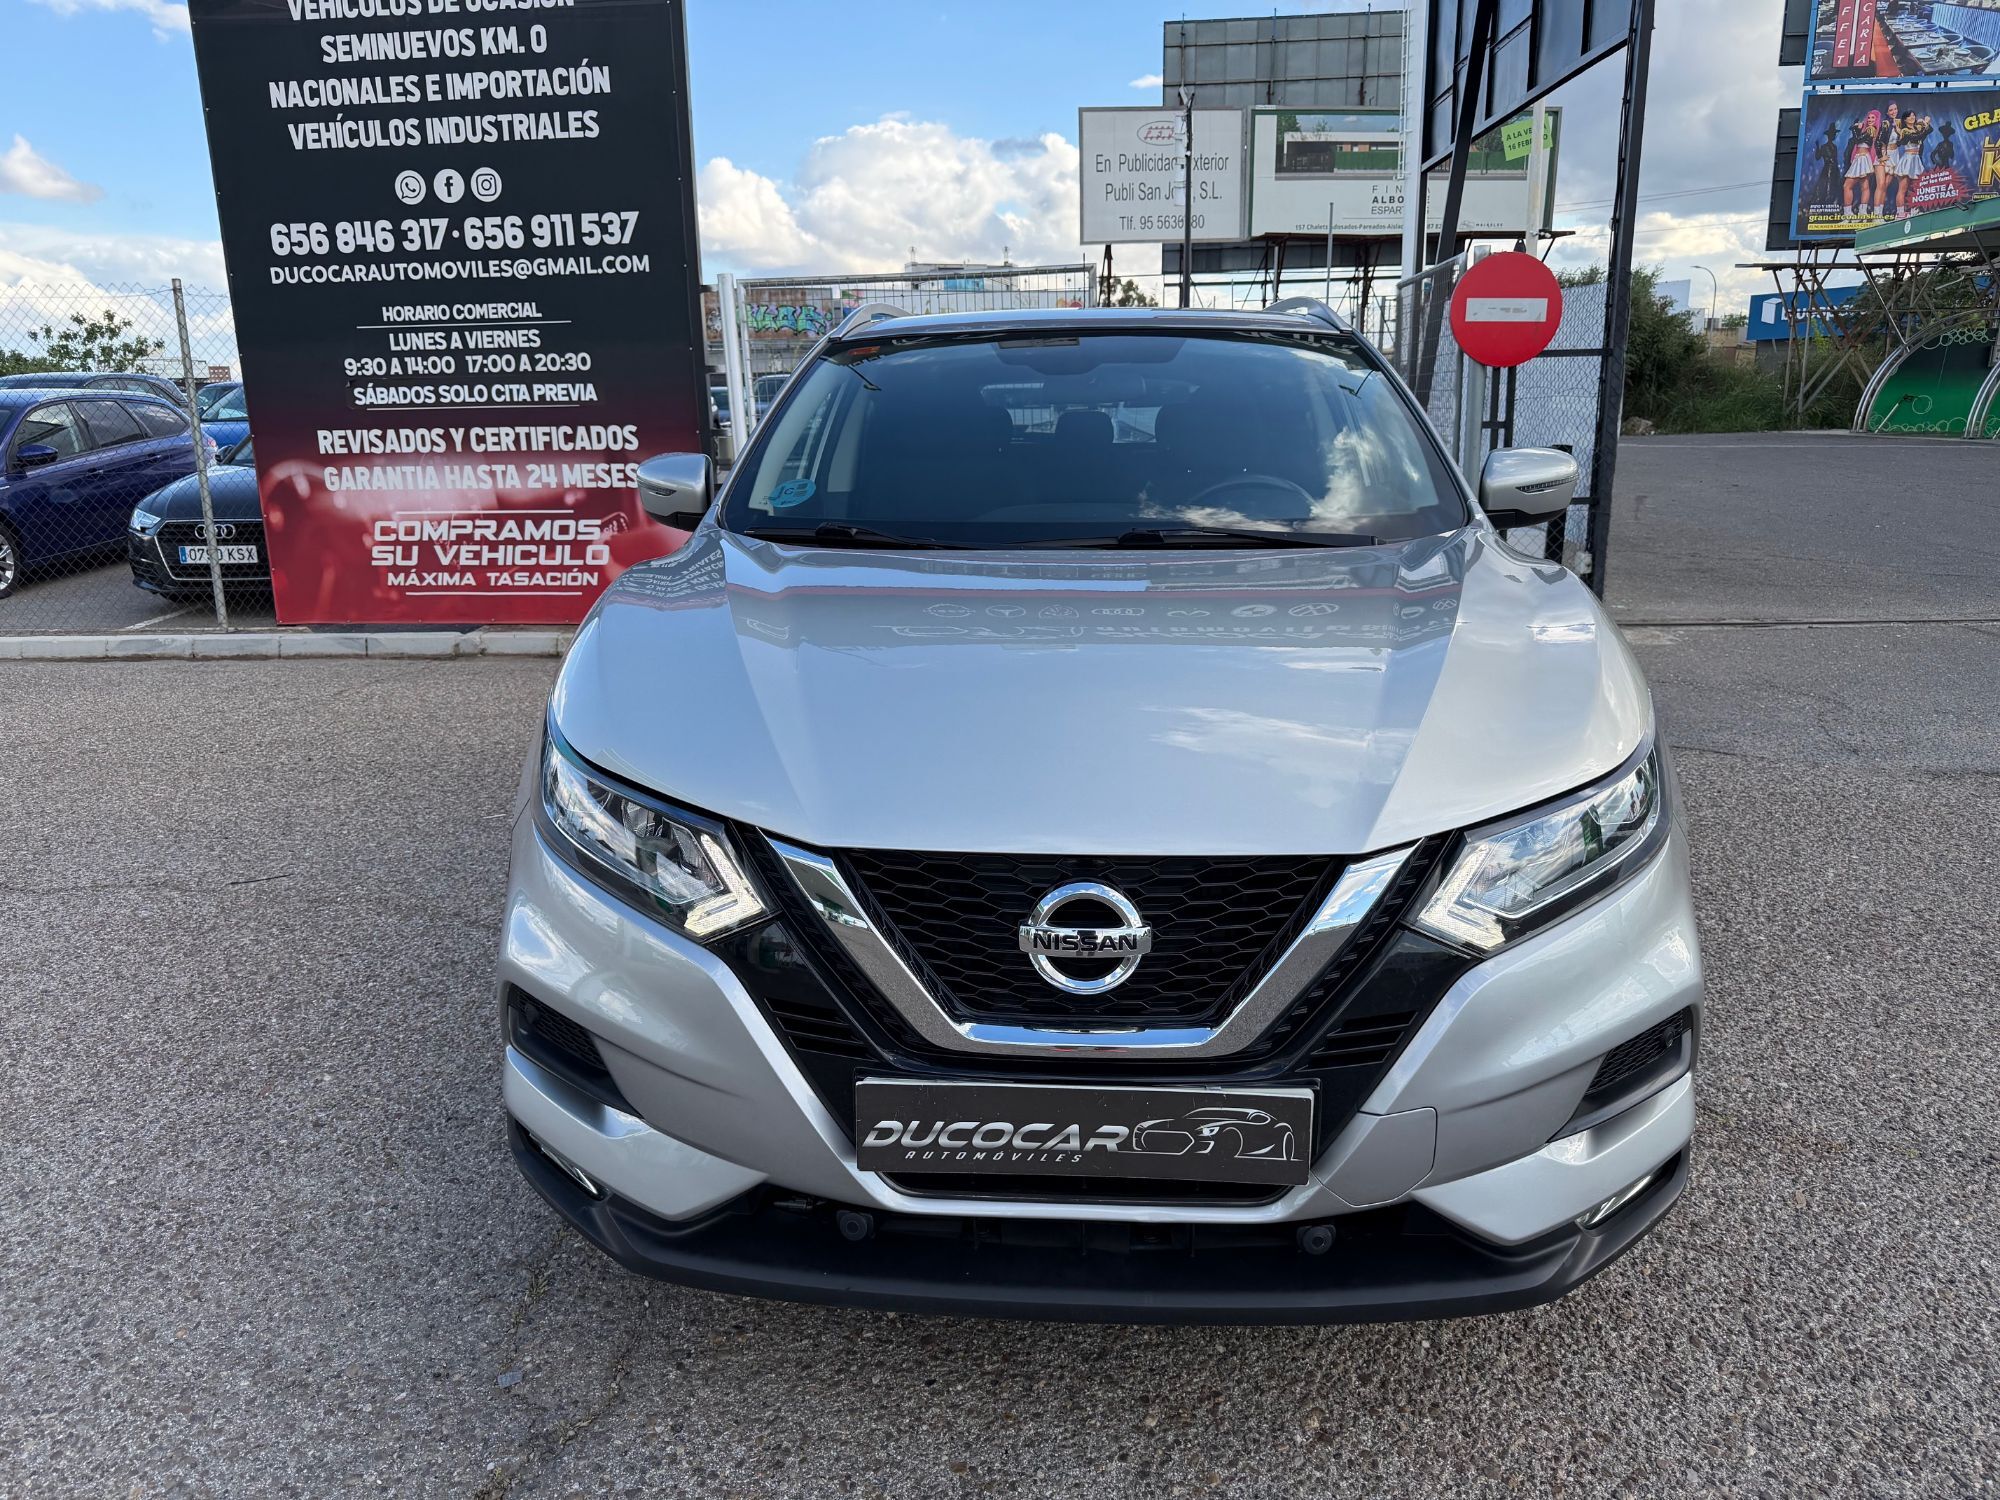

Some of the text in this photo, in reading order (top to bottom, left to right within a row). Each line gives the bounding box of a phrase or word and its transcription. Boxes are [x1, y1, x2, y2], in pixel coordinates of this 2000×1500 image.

[320, 28, 476, 64] SEMINUEVOS
[480, 26, 526, 56] KM.
[1856, 2, 1873, 64] CARTA
[268, 58, 612, 109] NACIONALES E IMPORTACIÓN
[287, 109, 600, 150] VEHÍCULOS INDUSTRIALES
[1095, 152, 1230, 173] En Publicida xterior
[1105, 182, 1135, 202] Publi
[1138, 182, 1161, 201] San
[1199, 181, 1223, 200] S.L.
[1911, 189, 1959, 203] NOSOTRAS!
[270, 222, 330, 256] 656
[335, 219, 396, 254] 846
[530, 213, 575, 248] 911
[581, 211, 640, 246] 537
[1119, 215, 1136, 231] Tlf.
[1139, 215, 1154, 230] 95
[270, 254, 650, 285] DUCOCARAUTOMOVILES@GMAIL.COM
[382, 302, 542, 322] HORARIO COMERCIAL
[389, 329, 541, 351] LUNES A VIERNES
[343, 352, 592, 377] 9:30 A 14:00 17:00 A 20:30
[353, 382, 598, 405] SÁBADOS SOLO CITA PREVIA
[317, 424, 639, 455] REVISADOS Y CERTIFICADOS
[323, 462, 638, 492] GARANTIA HASTA 24 MESES
[373, 518, 602, 542] COMPRAMOS
[227, 547, 255, 561] KSX
[371, 543, 610, 567] SU VEHICULO
[387, 568, 477, 587] MÁXIMA
[486, 567, 598, 587] TASACIÓN
[1033, 931, 1138, 952] NISSAN
[862, 1120, 1130, 1151] DUCOCAR
[904, 1149, 1083, 1163] AUTOMÓVILES
